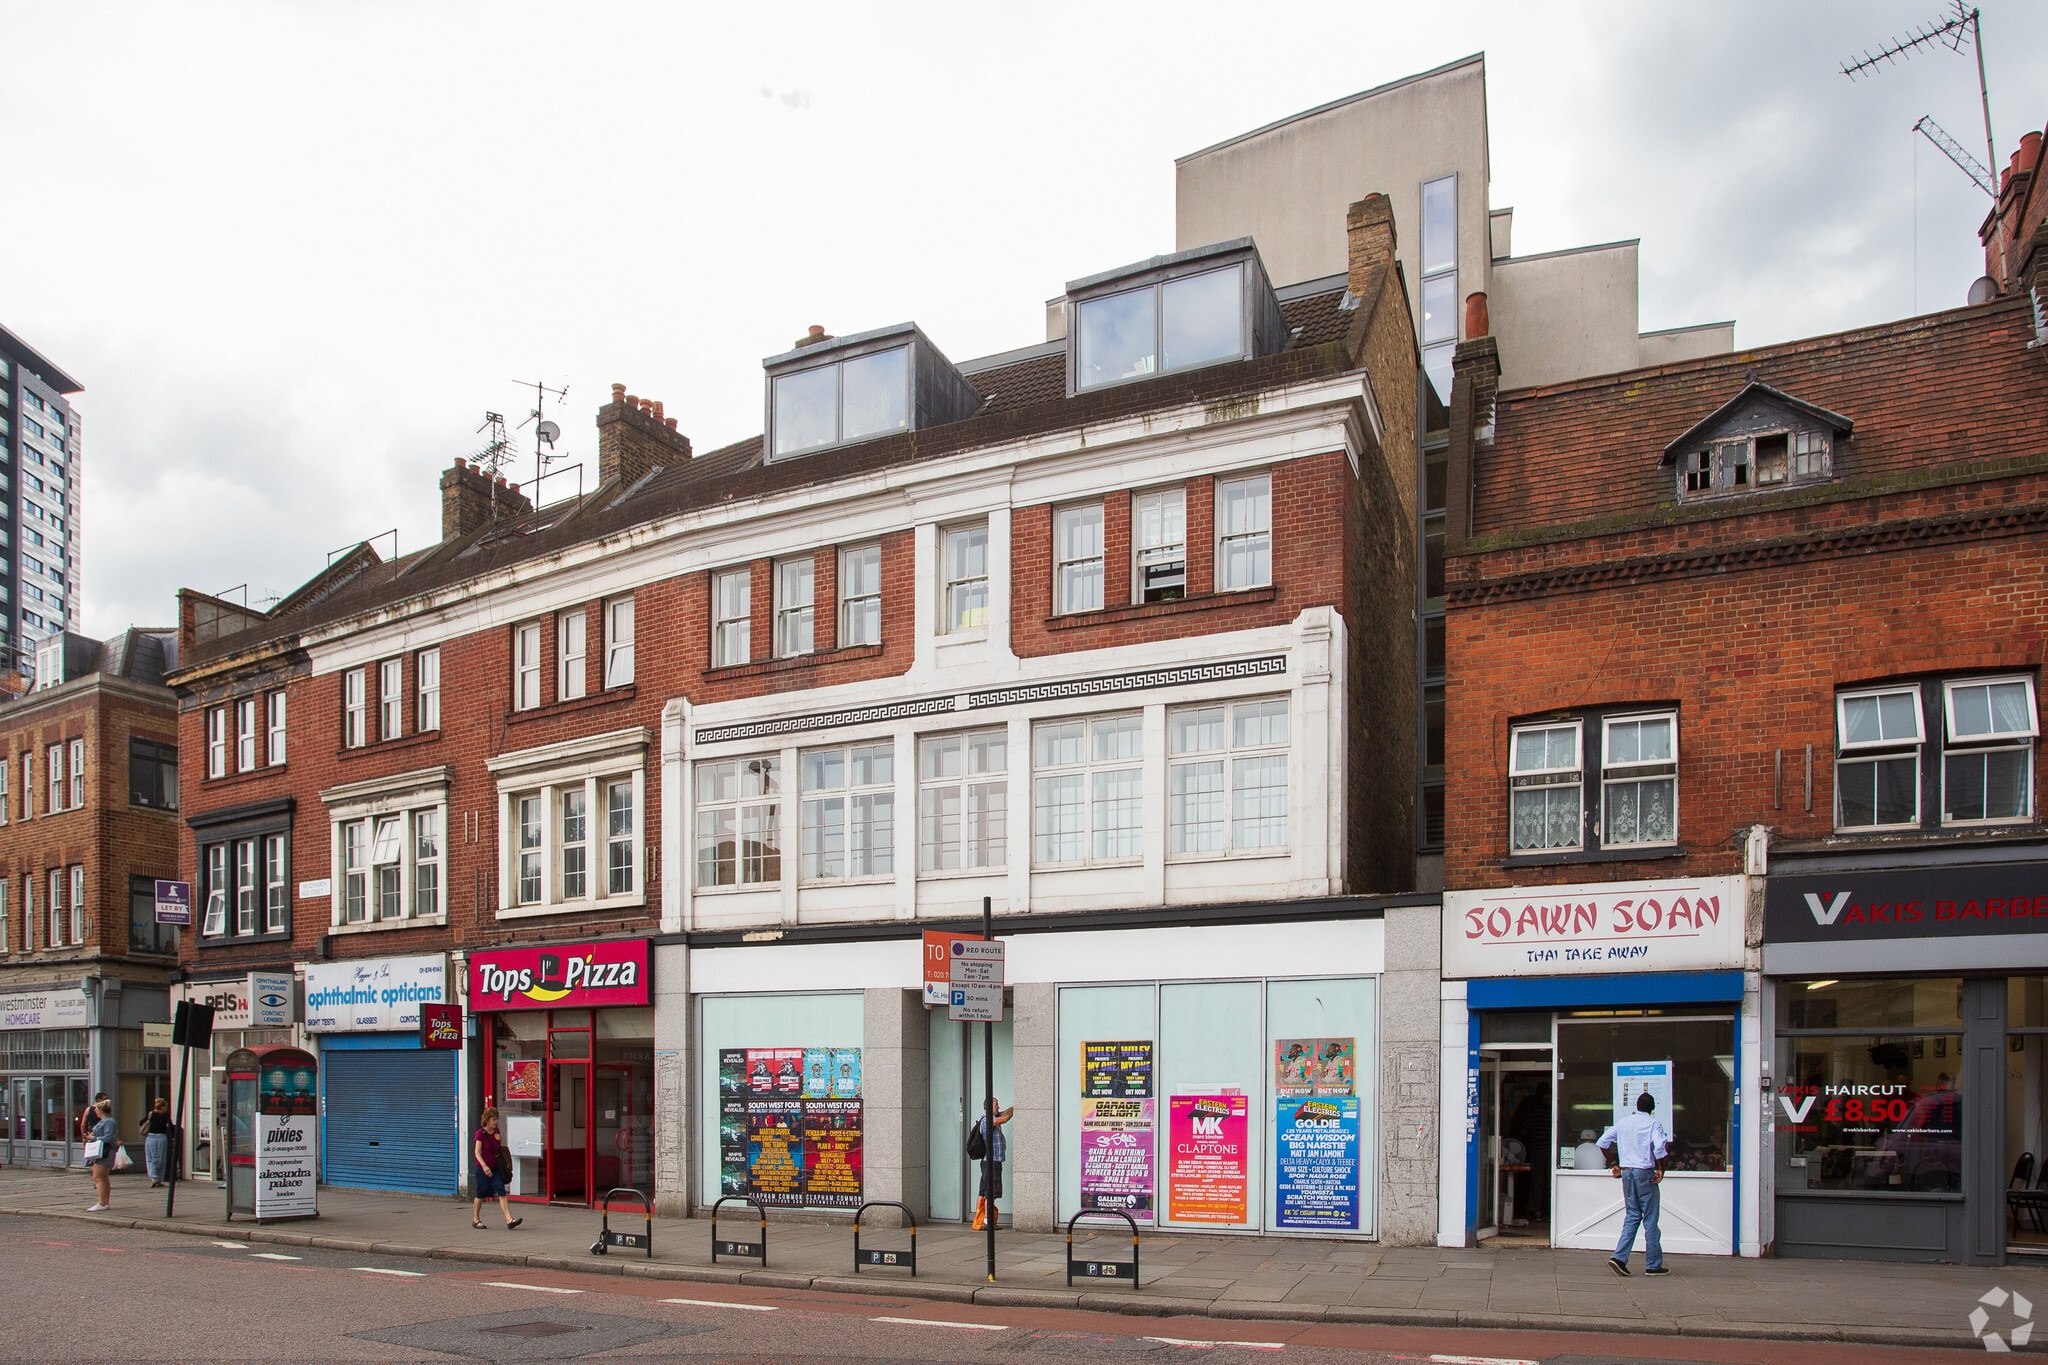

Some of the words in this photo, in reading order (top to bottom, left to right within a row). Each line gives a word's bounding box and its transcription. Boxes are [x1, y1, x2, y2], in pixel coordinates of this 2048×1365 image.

[1804, 891, 1923, 925] VAKIS
[1465, 902, 1597, 939] SOAWN
[1613, 895, 1720, 933] SOAN
[927, 944, 944, 960] TO
[1527, 949, 1558, 962] THAI
[1566, 948, 1602, 960] TAKE
[1607, 945, 1648, 959] AWAY
[257, 978, 289, 986] OPHTHALMIC
[480, 964, 532, 1002] Tops
[564, 954, 635, 989] Pizza
[205, 992, 237, 1011] REIS
[308, 984, 377, 1011] ophthalmic
[381, 982, 442, 1008] opticians
[0, 995, 47, 1011] westminster
[5, 1013, 40, 1025] HOMECARE
[431, 1019, 452, 1029] Tops
[433, 1030, 458, 1040] Pizza
[1087, 1046, 1116, 1057] WILEY
[1121, 1046, 1150, 1056] WILEY
[1088, 1062, 1099, 1072] MY
[1101, 1062, 1116, 1071] ONE
[1121, 1062, 1134, 1071] MY
[1135, 1061, 1150, 1071] ONE
[1778, 1085, 1818, 1094] VAKIS
[1826, 1085, 1907, 1095] HAIRCUT
[1195, 1104, 1230, 1114] ELECTRICS
[1199, 1099, 1226, 1108] EASTERN
[1307, 1101, 1338, 1110] EASTERN
[1304, 1106, 1340, 1117] ELECTRICS
[1824, 1099, 1907, 1122] £8.50
[1193, 1117, 1223, 1134] MK
[1295, 1119, 1340, 1128] GOLDIE
[267, 1128, 303, 1144] pixies
[1178, 1144, 1238, 1154] CLAPTONE
[259, 1168, 311, 1179] alexandra
[269, 1179, 302, 1190] palace
